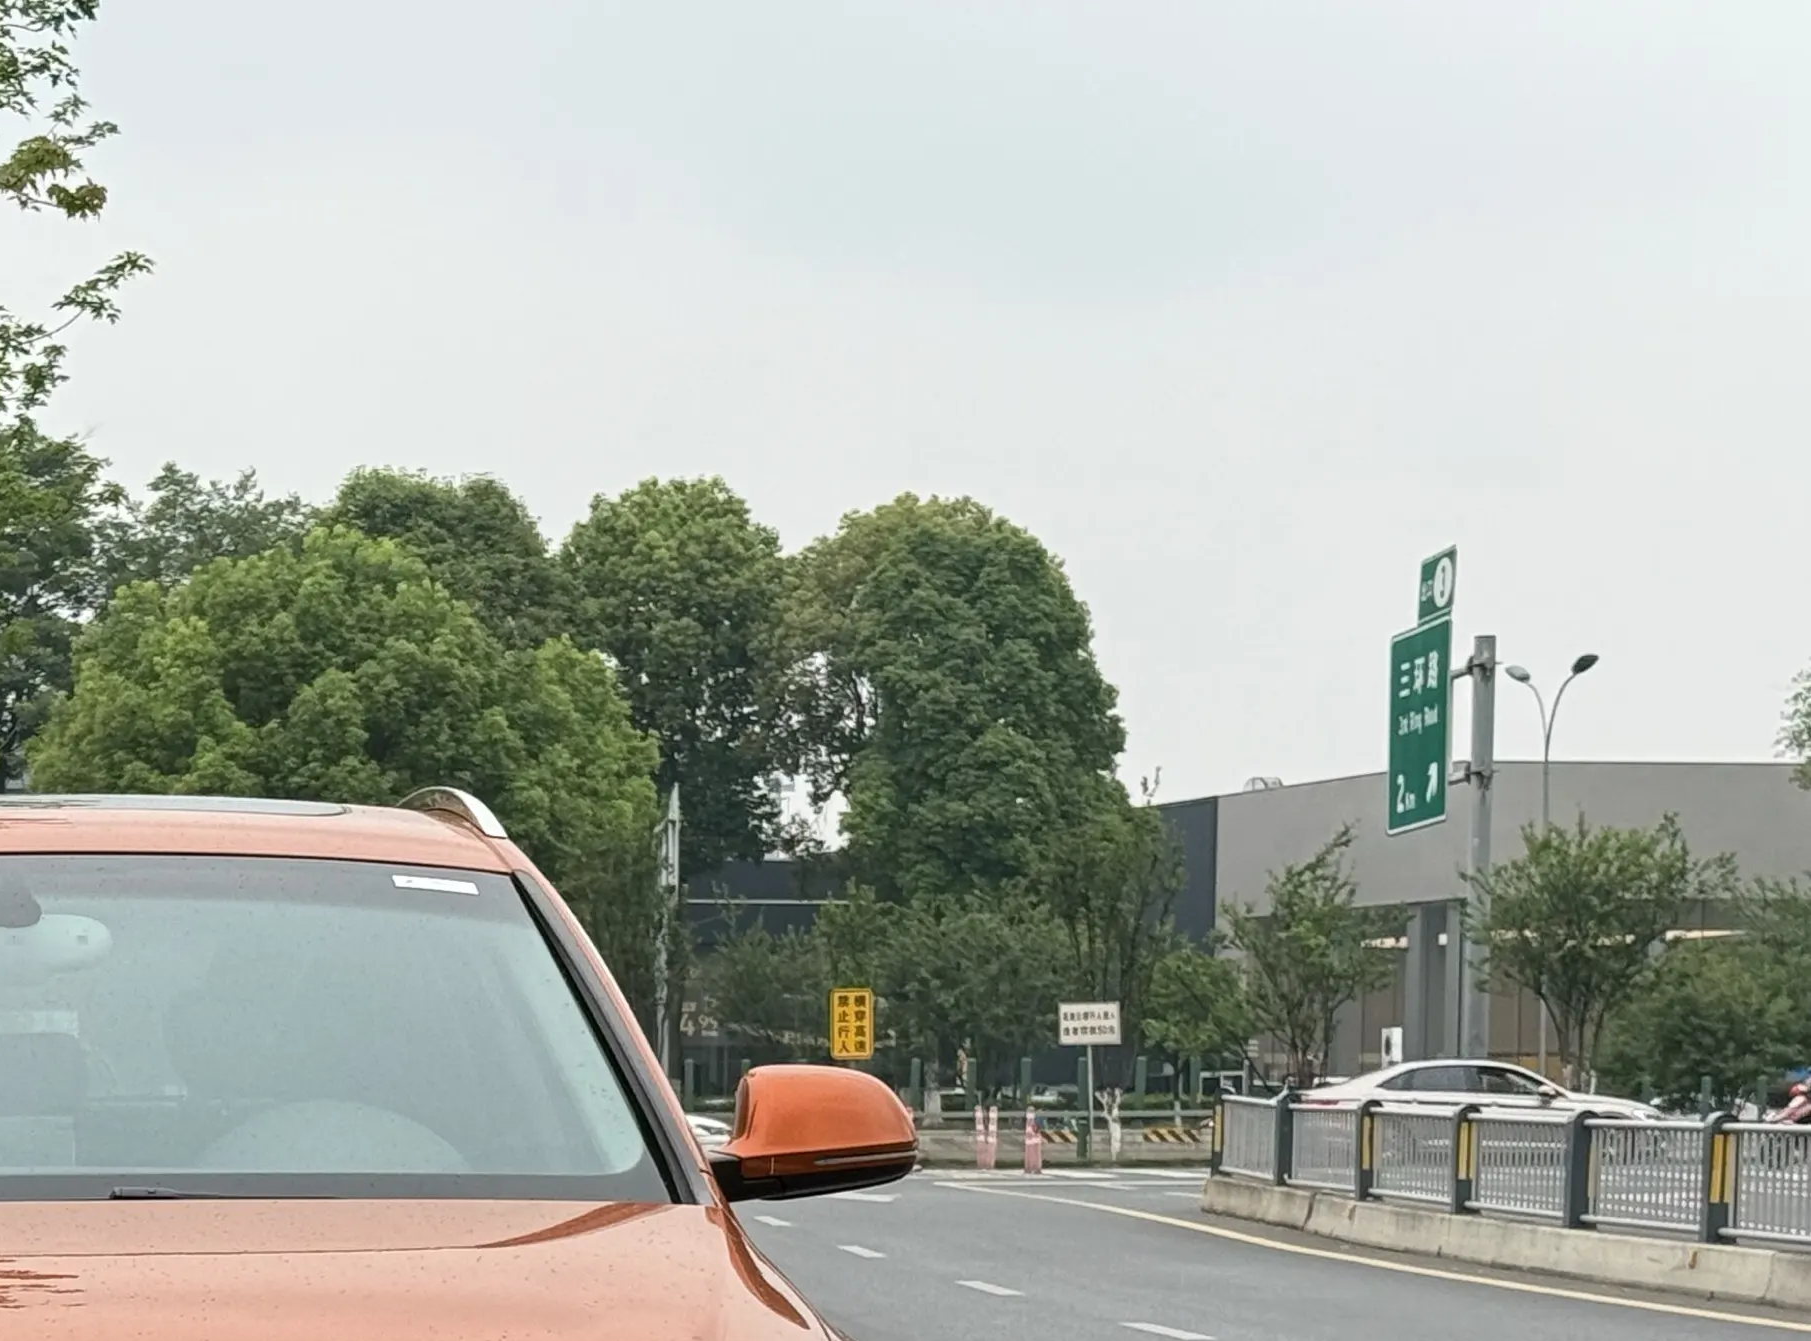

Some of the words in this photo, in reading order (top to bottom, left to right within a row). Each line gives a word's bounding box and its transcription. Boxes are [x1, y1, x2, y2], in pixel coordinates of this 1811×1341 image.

[1398, 650, 1439, 698] 三环路
[1409, 711, 1422, 734] Ring
[1424, 704, 1438, 727] Road
[837, 995, 850, 1053] 禁止行人
[854, 994, 867, 1053] 横穿高速
